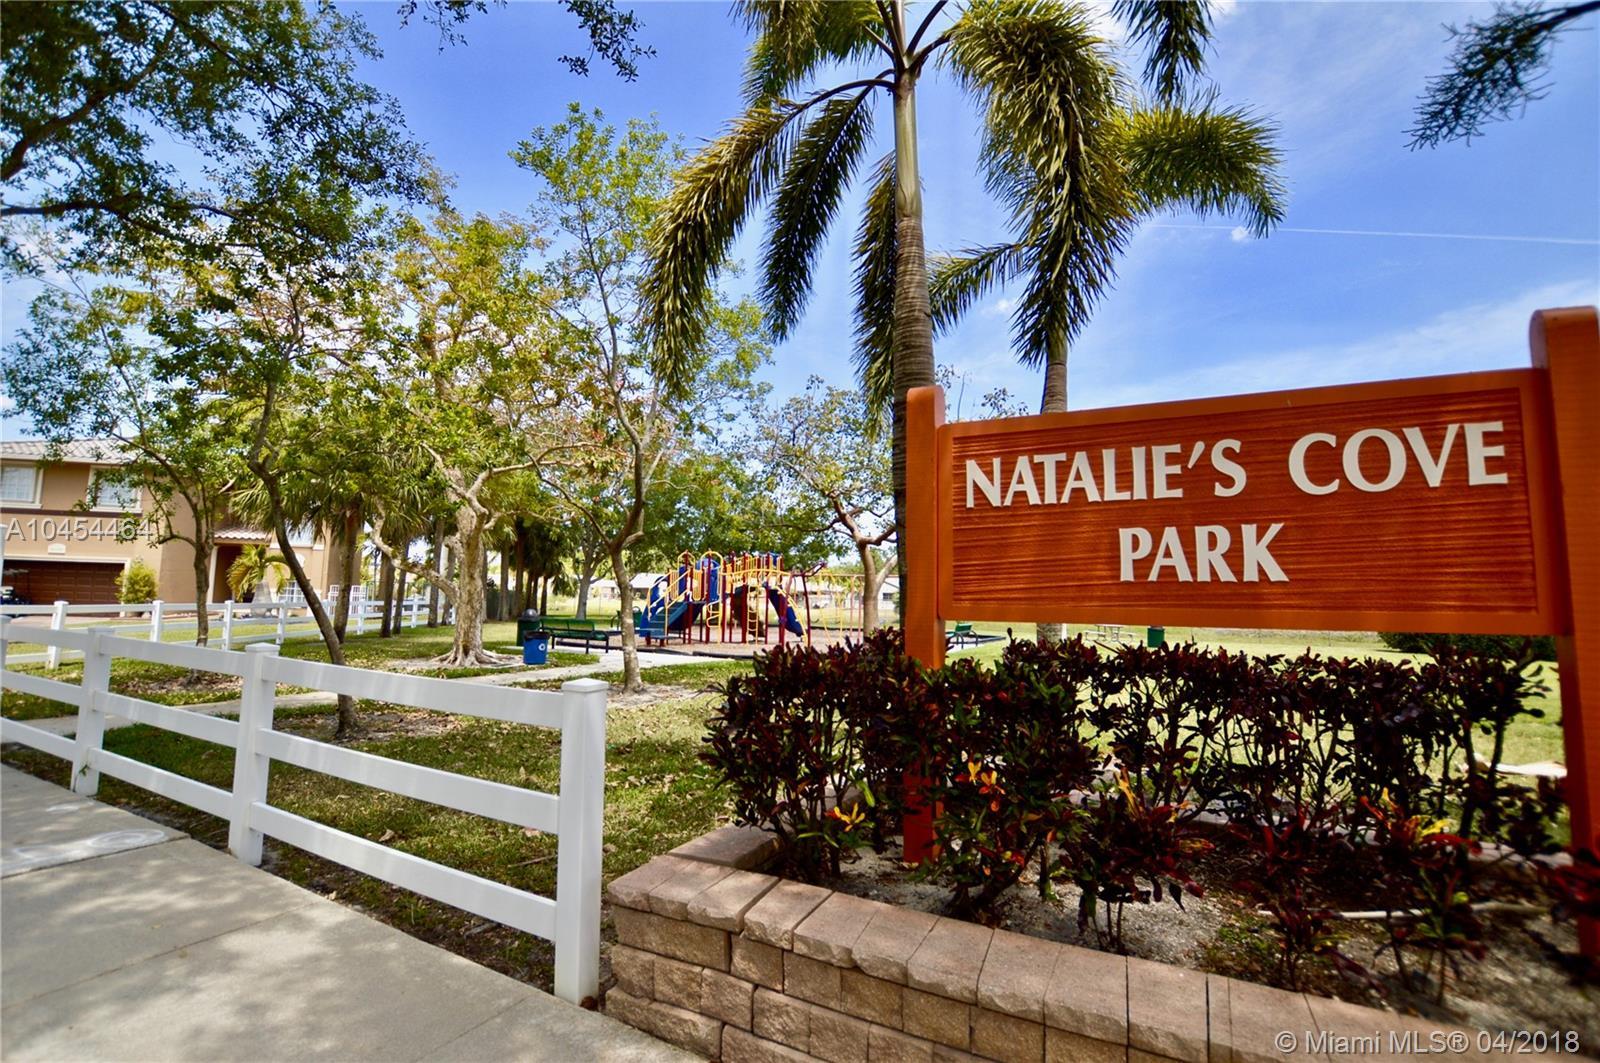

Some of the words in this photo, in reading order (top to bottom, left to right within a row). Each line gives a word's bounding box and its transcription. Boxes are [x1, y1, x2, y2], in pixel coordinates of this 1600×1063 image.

[965, 438, 1247, 508] NATALIE'S
[1288, 420, 1508, 496] COVE
[1118, 522, 1290, 583] PARK
